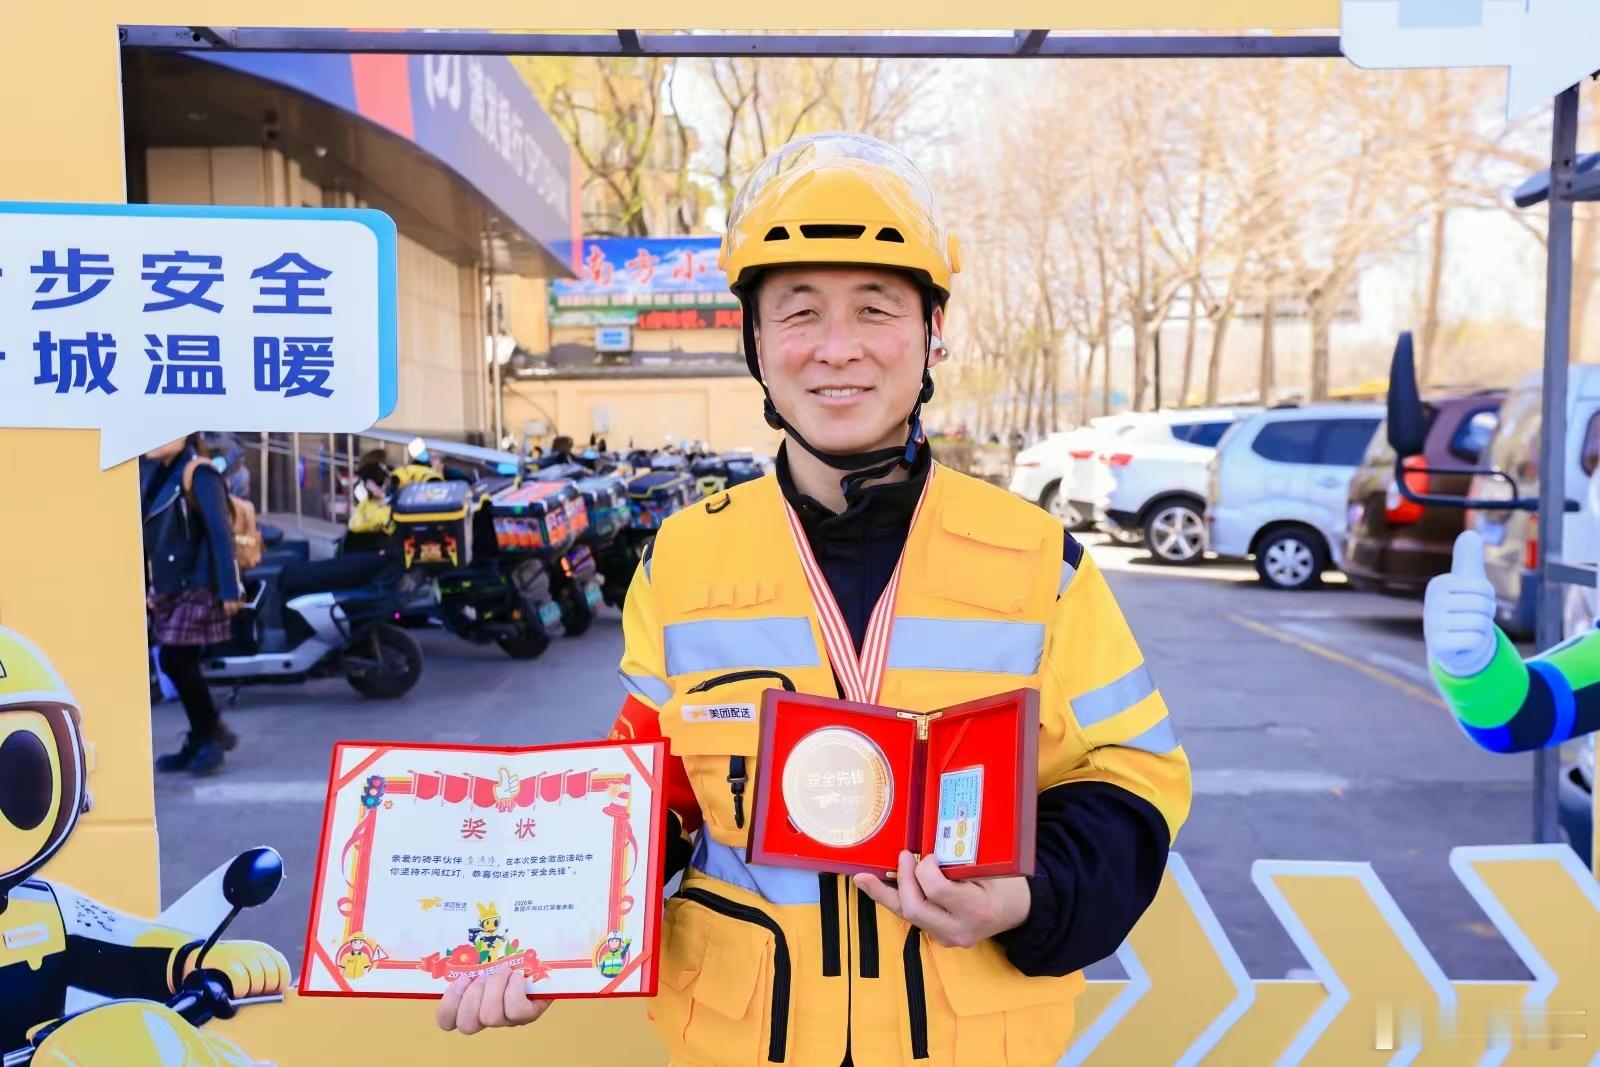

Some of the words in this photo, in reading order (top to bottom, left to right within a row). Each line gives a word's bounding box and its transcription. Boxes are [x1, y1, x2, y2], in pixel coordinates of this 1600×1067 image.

[0, 248, 334, 315] 步安全
[564, 244, 722, 287] 南方小
[0, 330, 335, 398] 城温暖
[708, 707, 751, 719] 美团配送
[460, 817, 536, 839] 奖状
